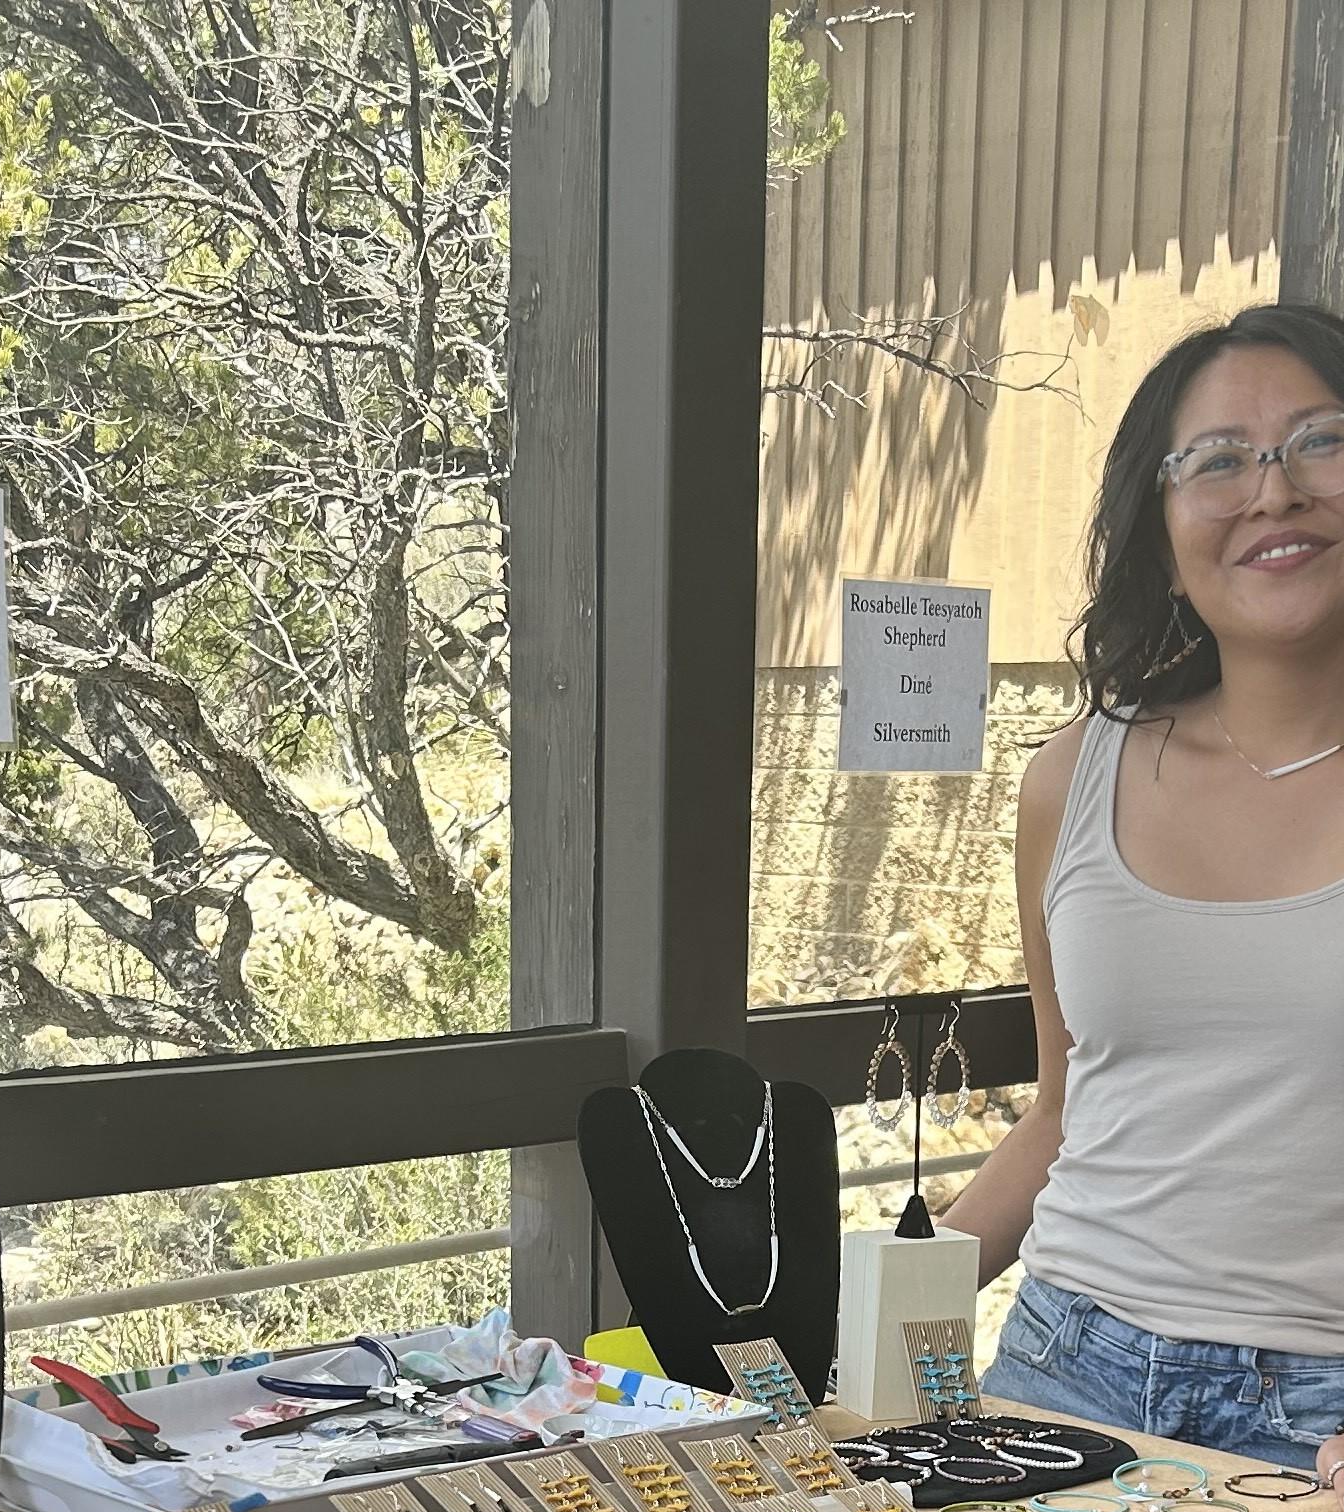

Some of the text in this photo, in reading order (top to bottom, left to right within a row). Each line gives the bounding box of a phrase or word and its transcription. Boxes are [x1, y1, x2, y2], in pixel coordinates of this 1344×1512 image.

[850, 593, 983, 623] Rosabelle Teesyatoh
[884, 626, 946, 651] Shepherd
[899, 674, 933, 695] Diné
[873, 722, 951, 743] Silversmith
